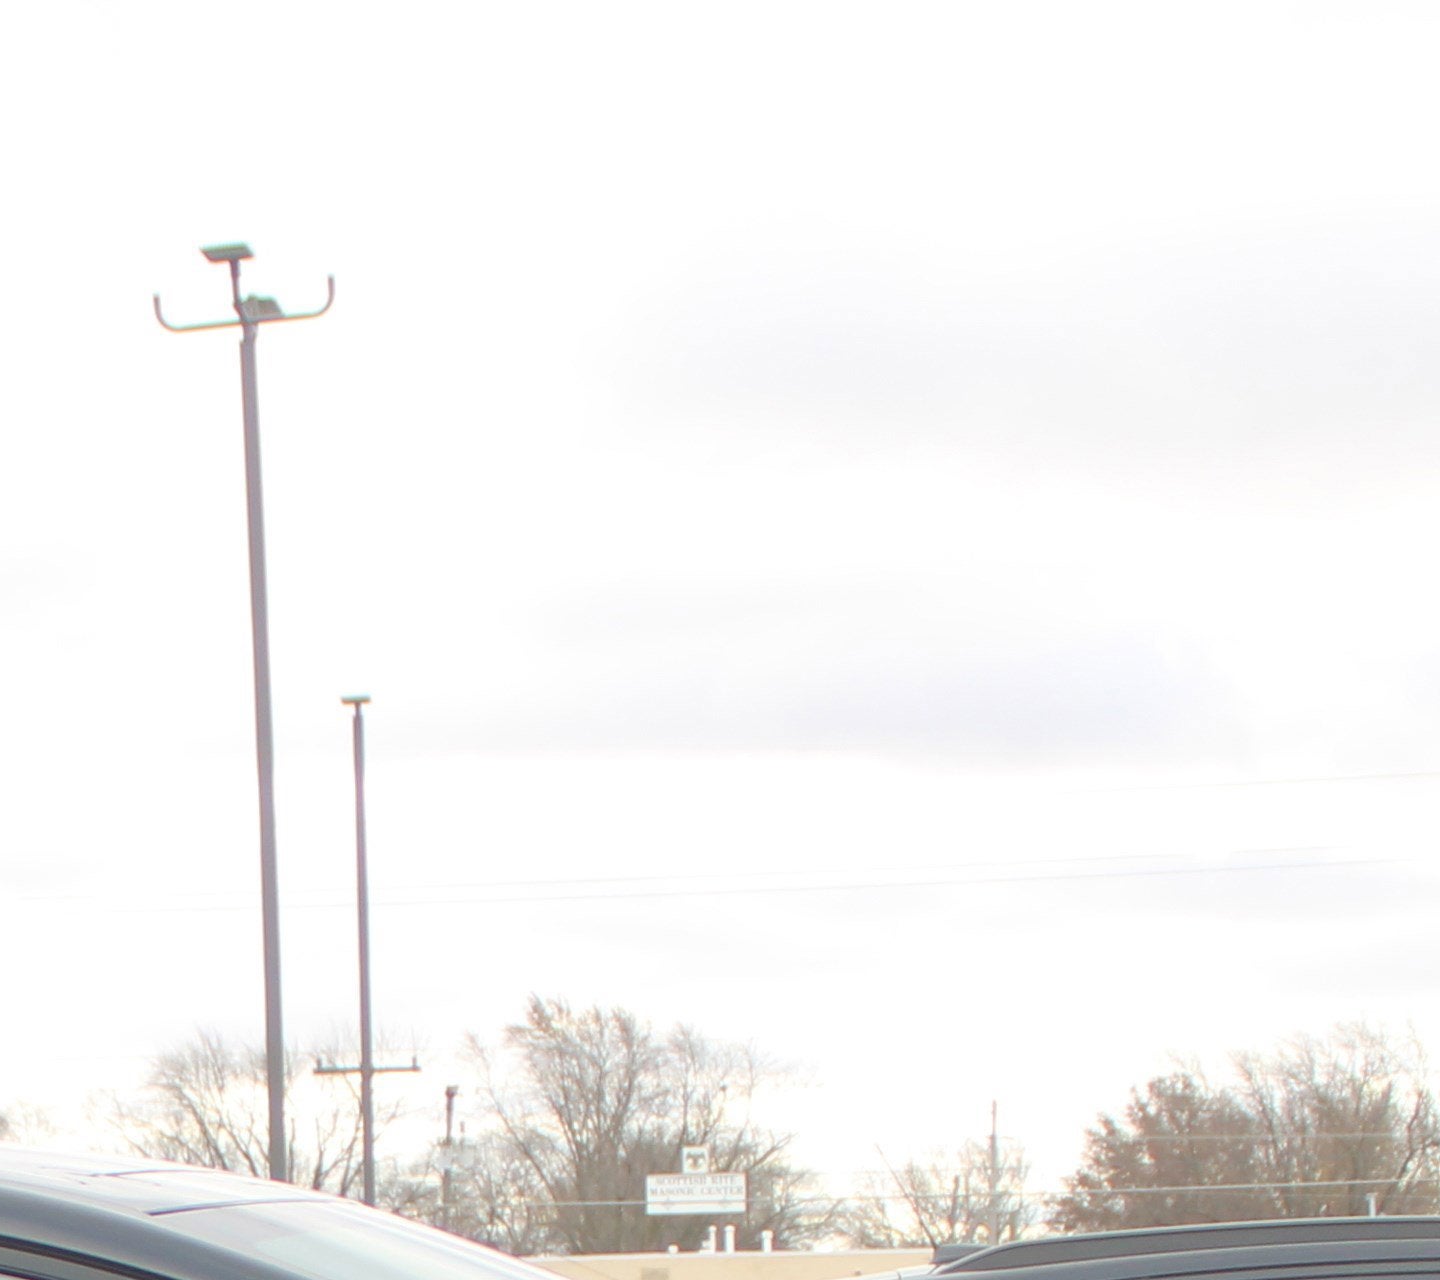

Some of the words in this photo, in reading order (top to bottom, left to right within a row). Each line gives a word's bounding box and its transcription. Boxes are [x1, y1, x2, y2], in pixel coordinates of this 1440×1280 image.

[656, 1174, 707, 1186] SCOTTISH
[711, 1174, 737, 1185] RITE
[650, 1186, 694, 1196] MASONIC
[700, 1186, 744, 1196] CENTER
